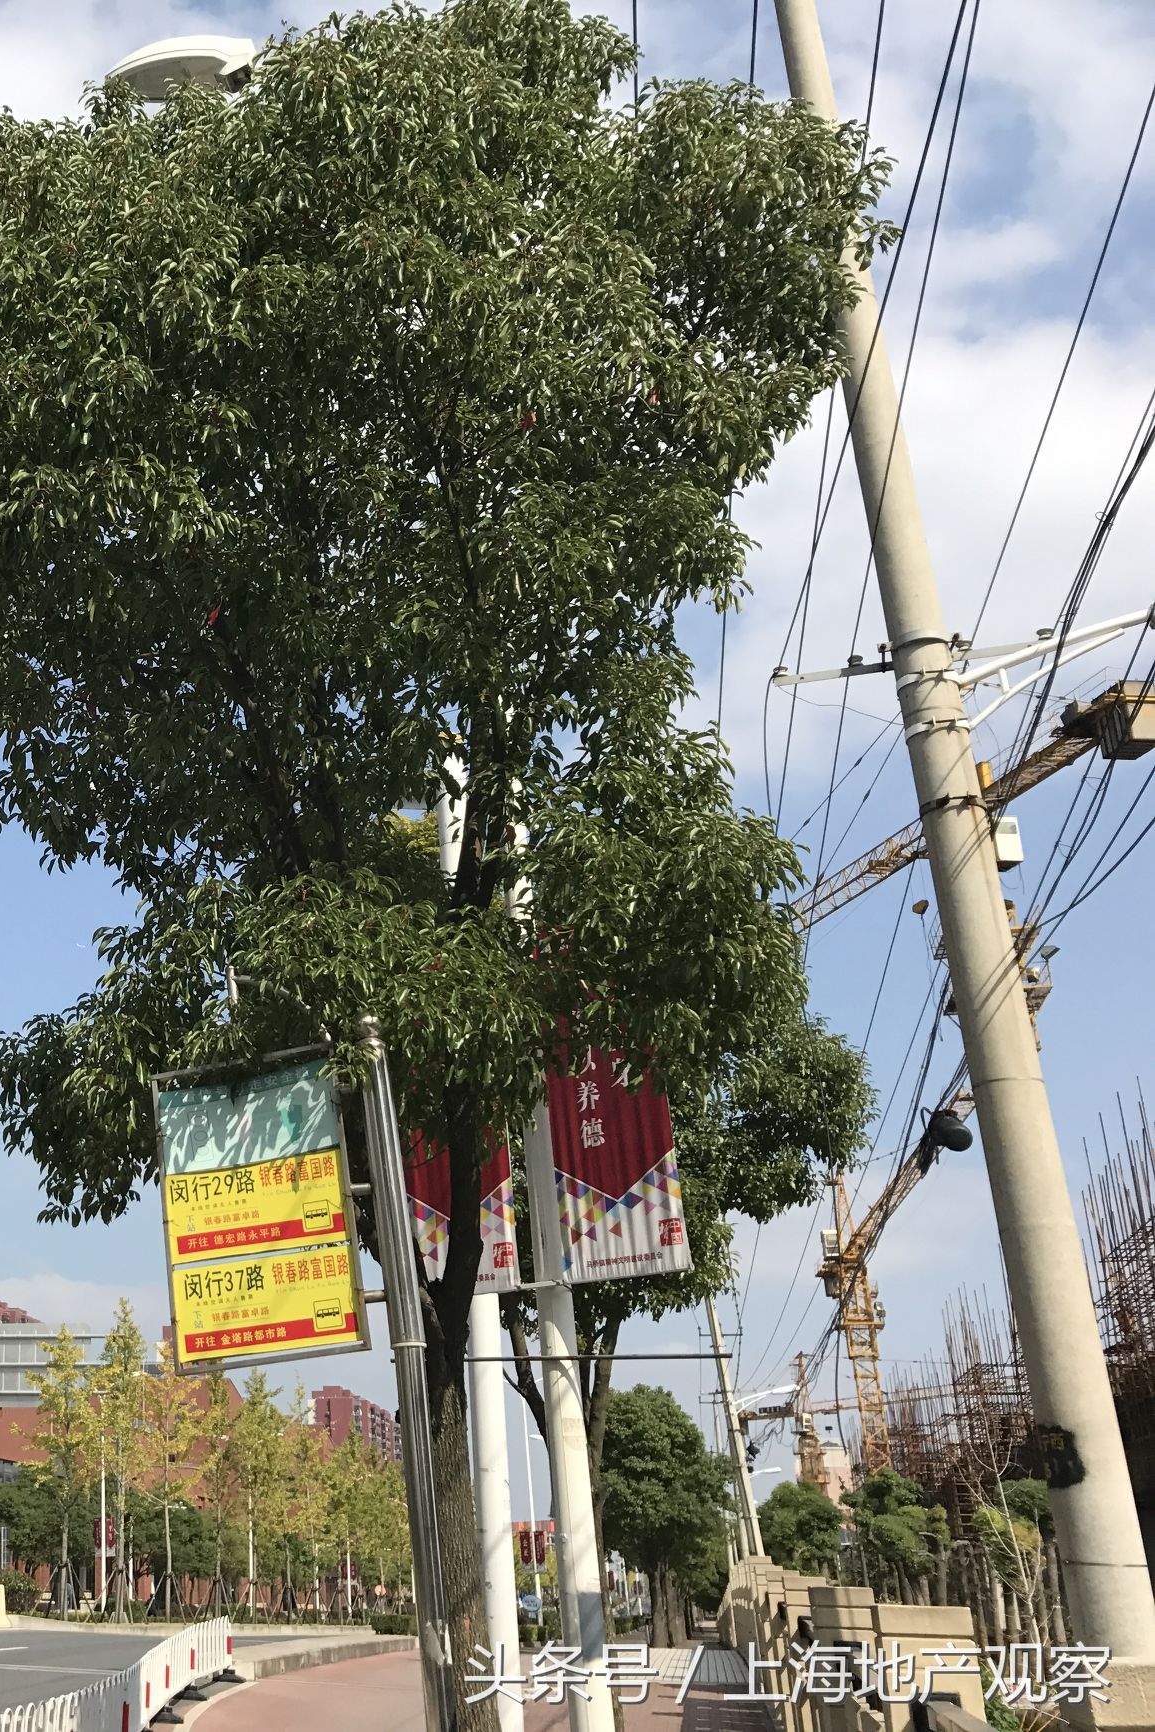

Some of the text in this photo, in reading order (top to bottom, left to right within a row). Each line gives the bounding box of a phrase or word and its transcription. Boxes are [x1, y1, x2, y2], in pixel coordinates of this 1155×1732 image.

[169, 1168, 255, 1206] 闵行29路
[258, 1155, 335, 1188] 银春路富国路
[187, 1226, 281, 1249] 开往 德宏路永平路
[184, 1264, 264, 1301] 闵行37路
[271, 1253, 349, 1285] 银春路富国路
[194, 1326, 287, 1349] 开往 金塔路都市路
